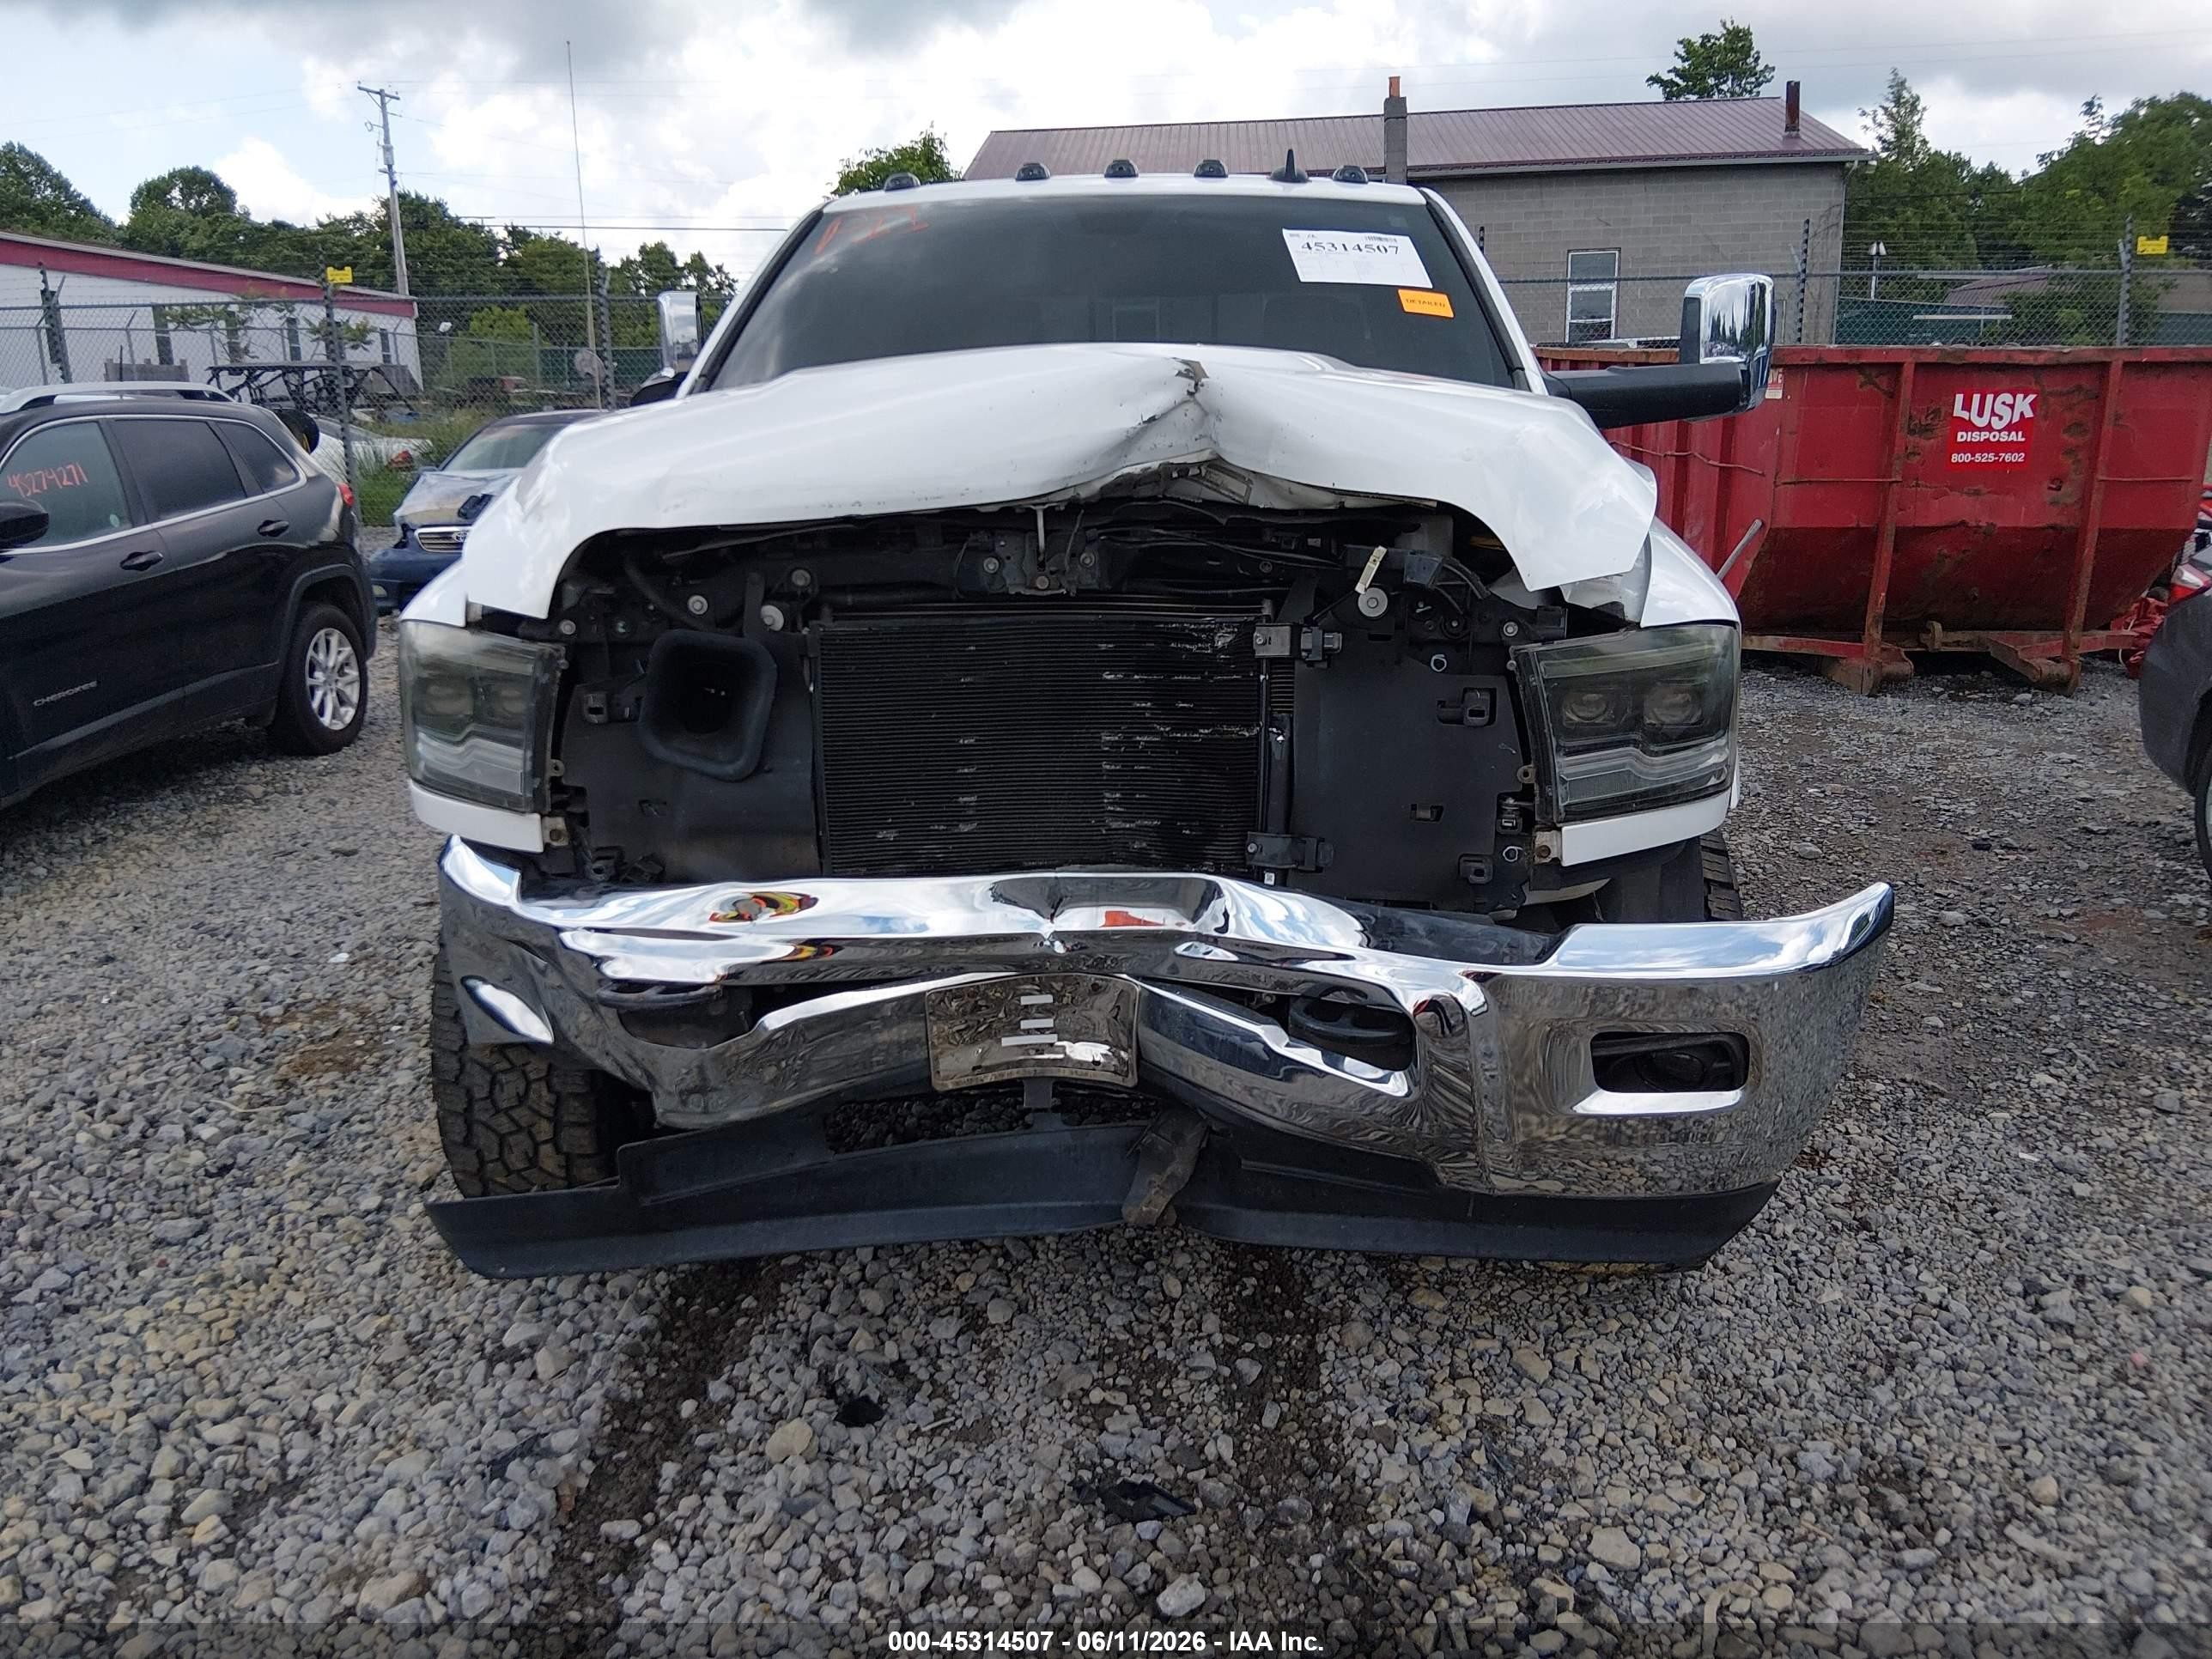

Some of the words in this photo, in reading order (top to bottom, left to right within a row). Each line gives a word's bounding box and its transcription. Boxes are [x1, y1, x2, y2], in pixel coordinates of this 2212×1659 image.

[1301, 241, 1399, 255] 45314507
[1953, 392, 2039, 430] LUSK
[1956, 430, 2027, 442] DISPOSAL
[1950, 452, 2026, 463] 800-525-7602
[7, 461, 88, 498] 45274271
[33, 680, 98, 707] CHEROKEE
